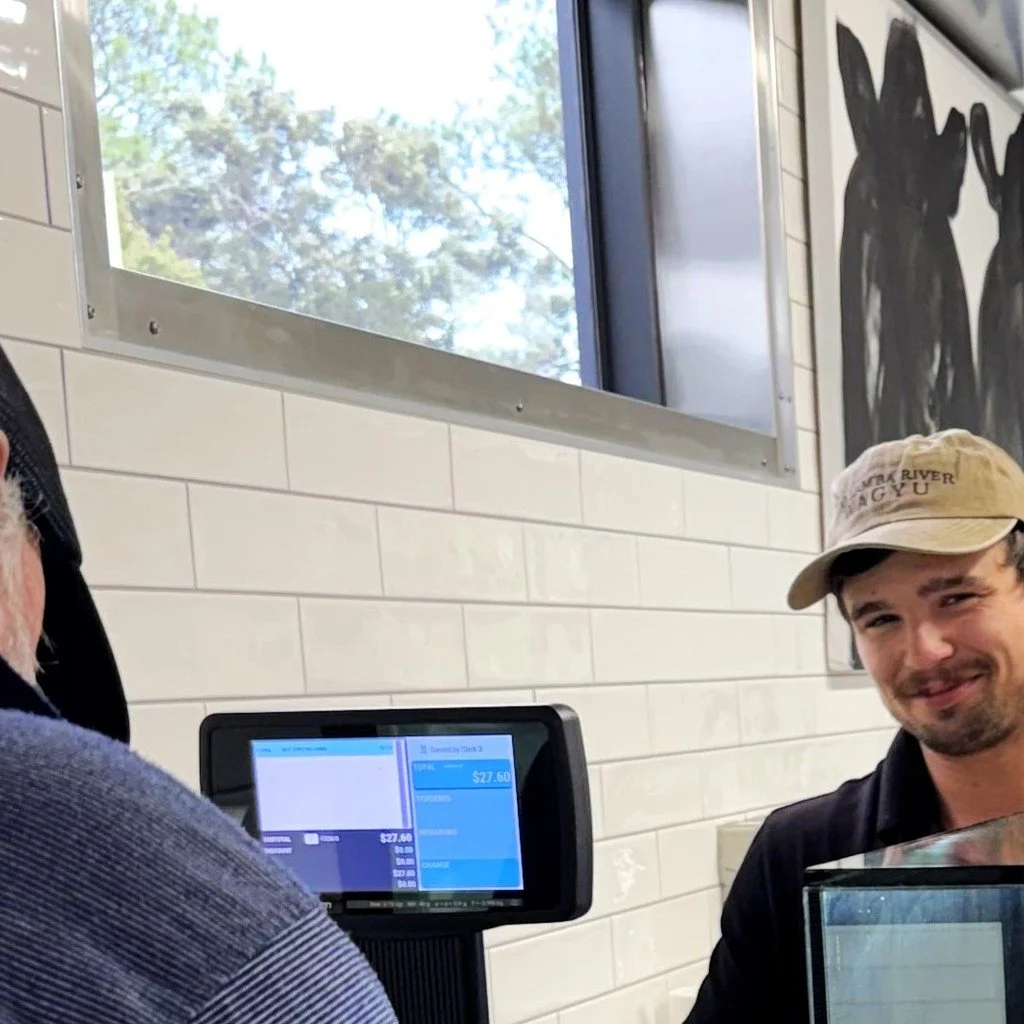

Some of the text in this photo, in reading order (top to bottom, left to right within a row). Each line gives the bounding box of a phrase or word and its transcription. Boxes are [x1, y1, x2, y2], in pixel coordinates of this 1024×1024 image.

[901, 469, 955, 485] RIVER
[472, 770, 511, 784] $27.60
[380, 832, 413, 844] $27.60
